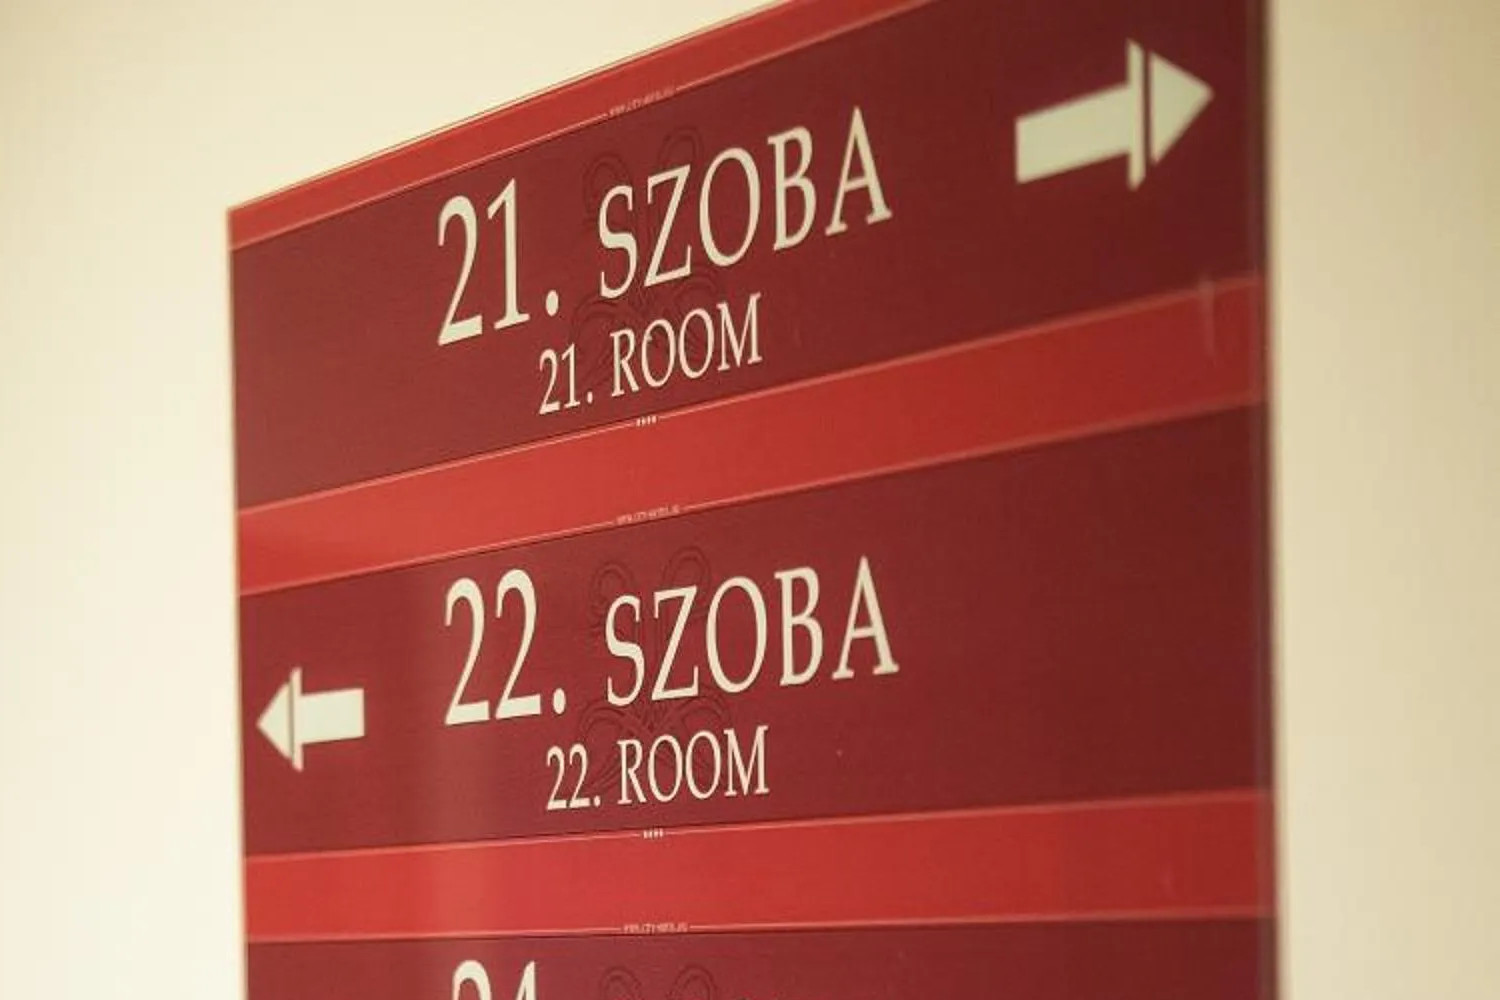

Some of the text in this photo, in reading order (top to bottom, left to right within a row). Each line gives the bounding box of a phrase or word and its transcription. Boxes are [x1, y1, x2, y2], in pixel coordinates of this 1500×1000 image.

[437, 108, 892, 346] 21. SZOBA
[539, 292, 763, 415] 21. ROOM
[444, 556, 899, 726] 22. SZOBA
[546, 725, 770, 811] 22. ROOM
